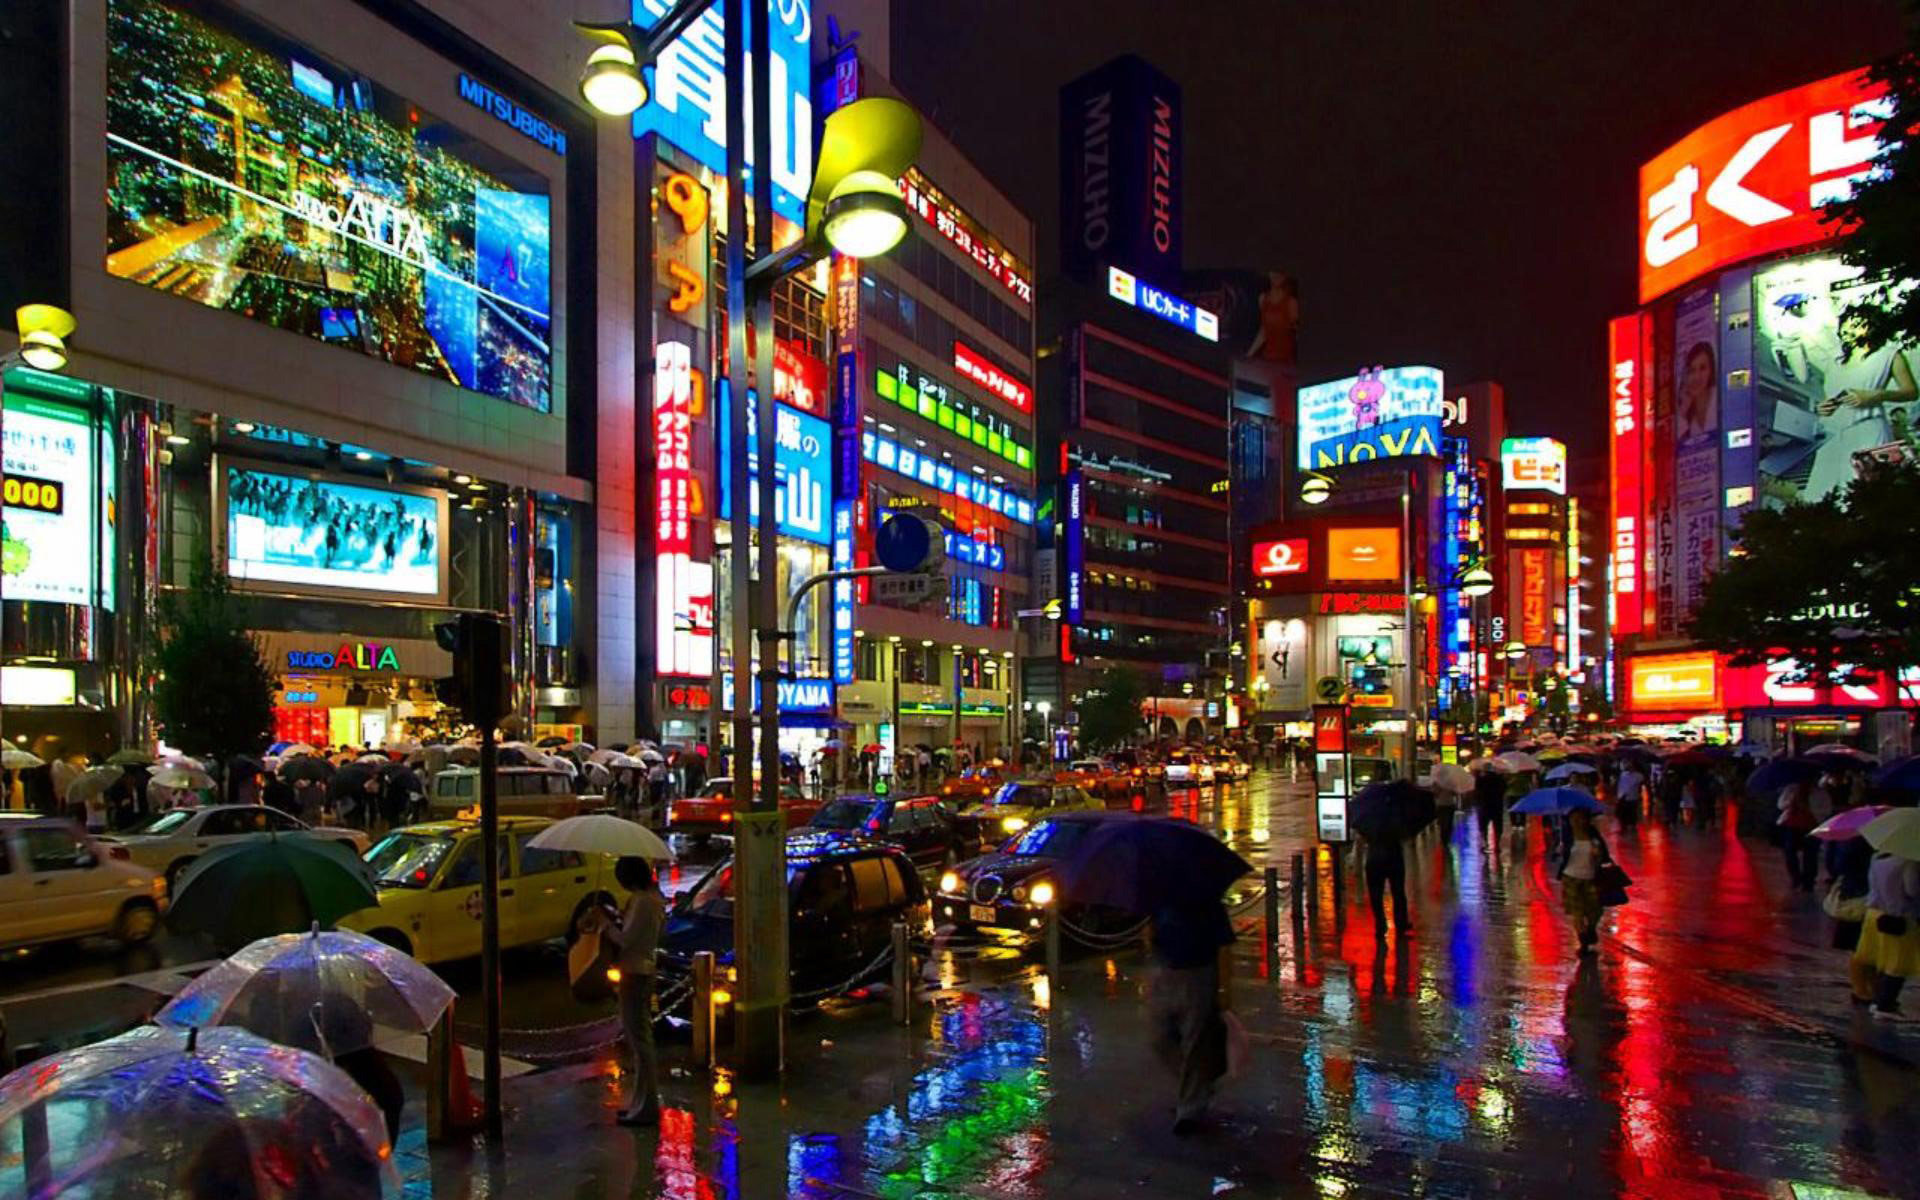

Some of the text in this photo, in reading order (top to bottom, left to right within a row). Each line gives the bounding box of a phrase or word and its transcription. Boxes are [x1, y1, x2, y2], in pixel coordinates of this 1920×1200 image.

[460, 74, 567, 155] MITSUBISHI
[1083, 91, 1111, 252] MIZUHO
[1153, 96, 1171, 254] MIZUHO
[341, 192, 427, 264] ALTA
[1142, 286, 1190, 323] UCカード
[288, 642, 400, 672] STUDIO ALTA
[1321, 679, 1338, 697] 2
